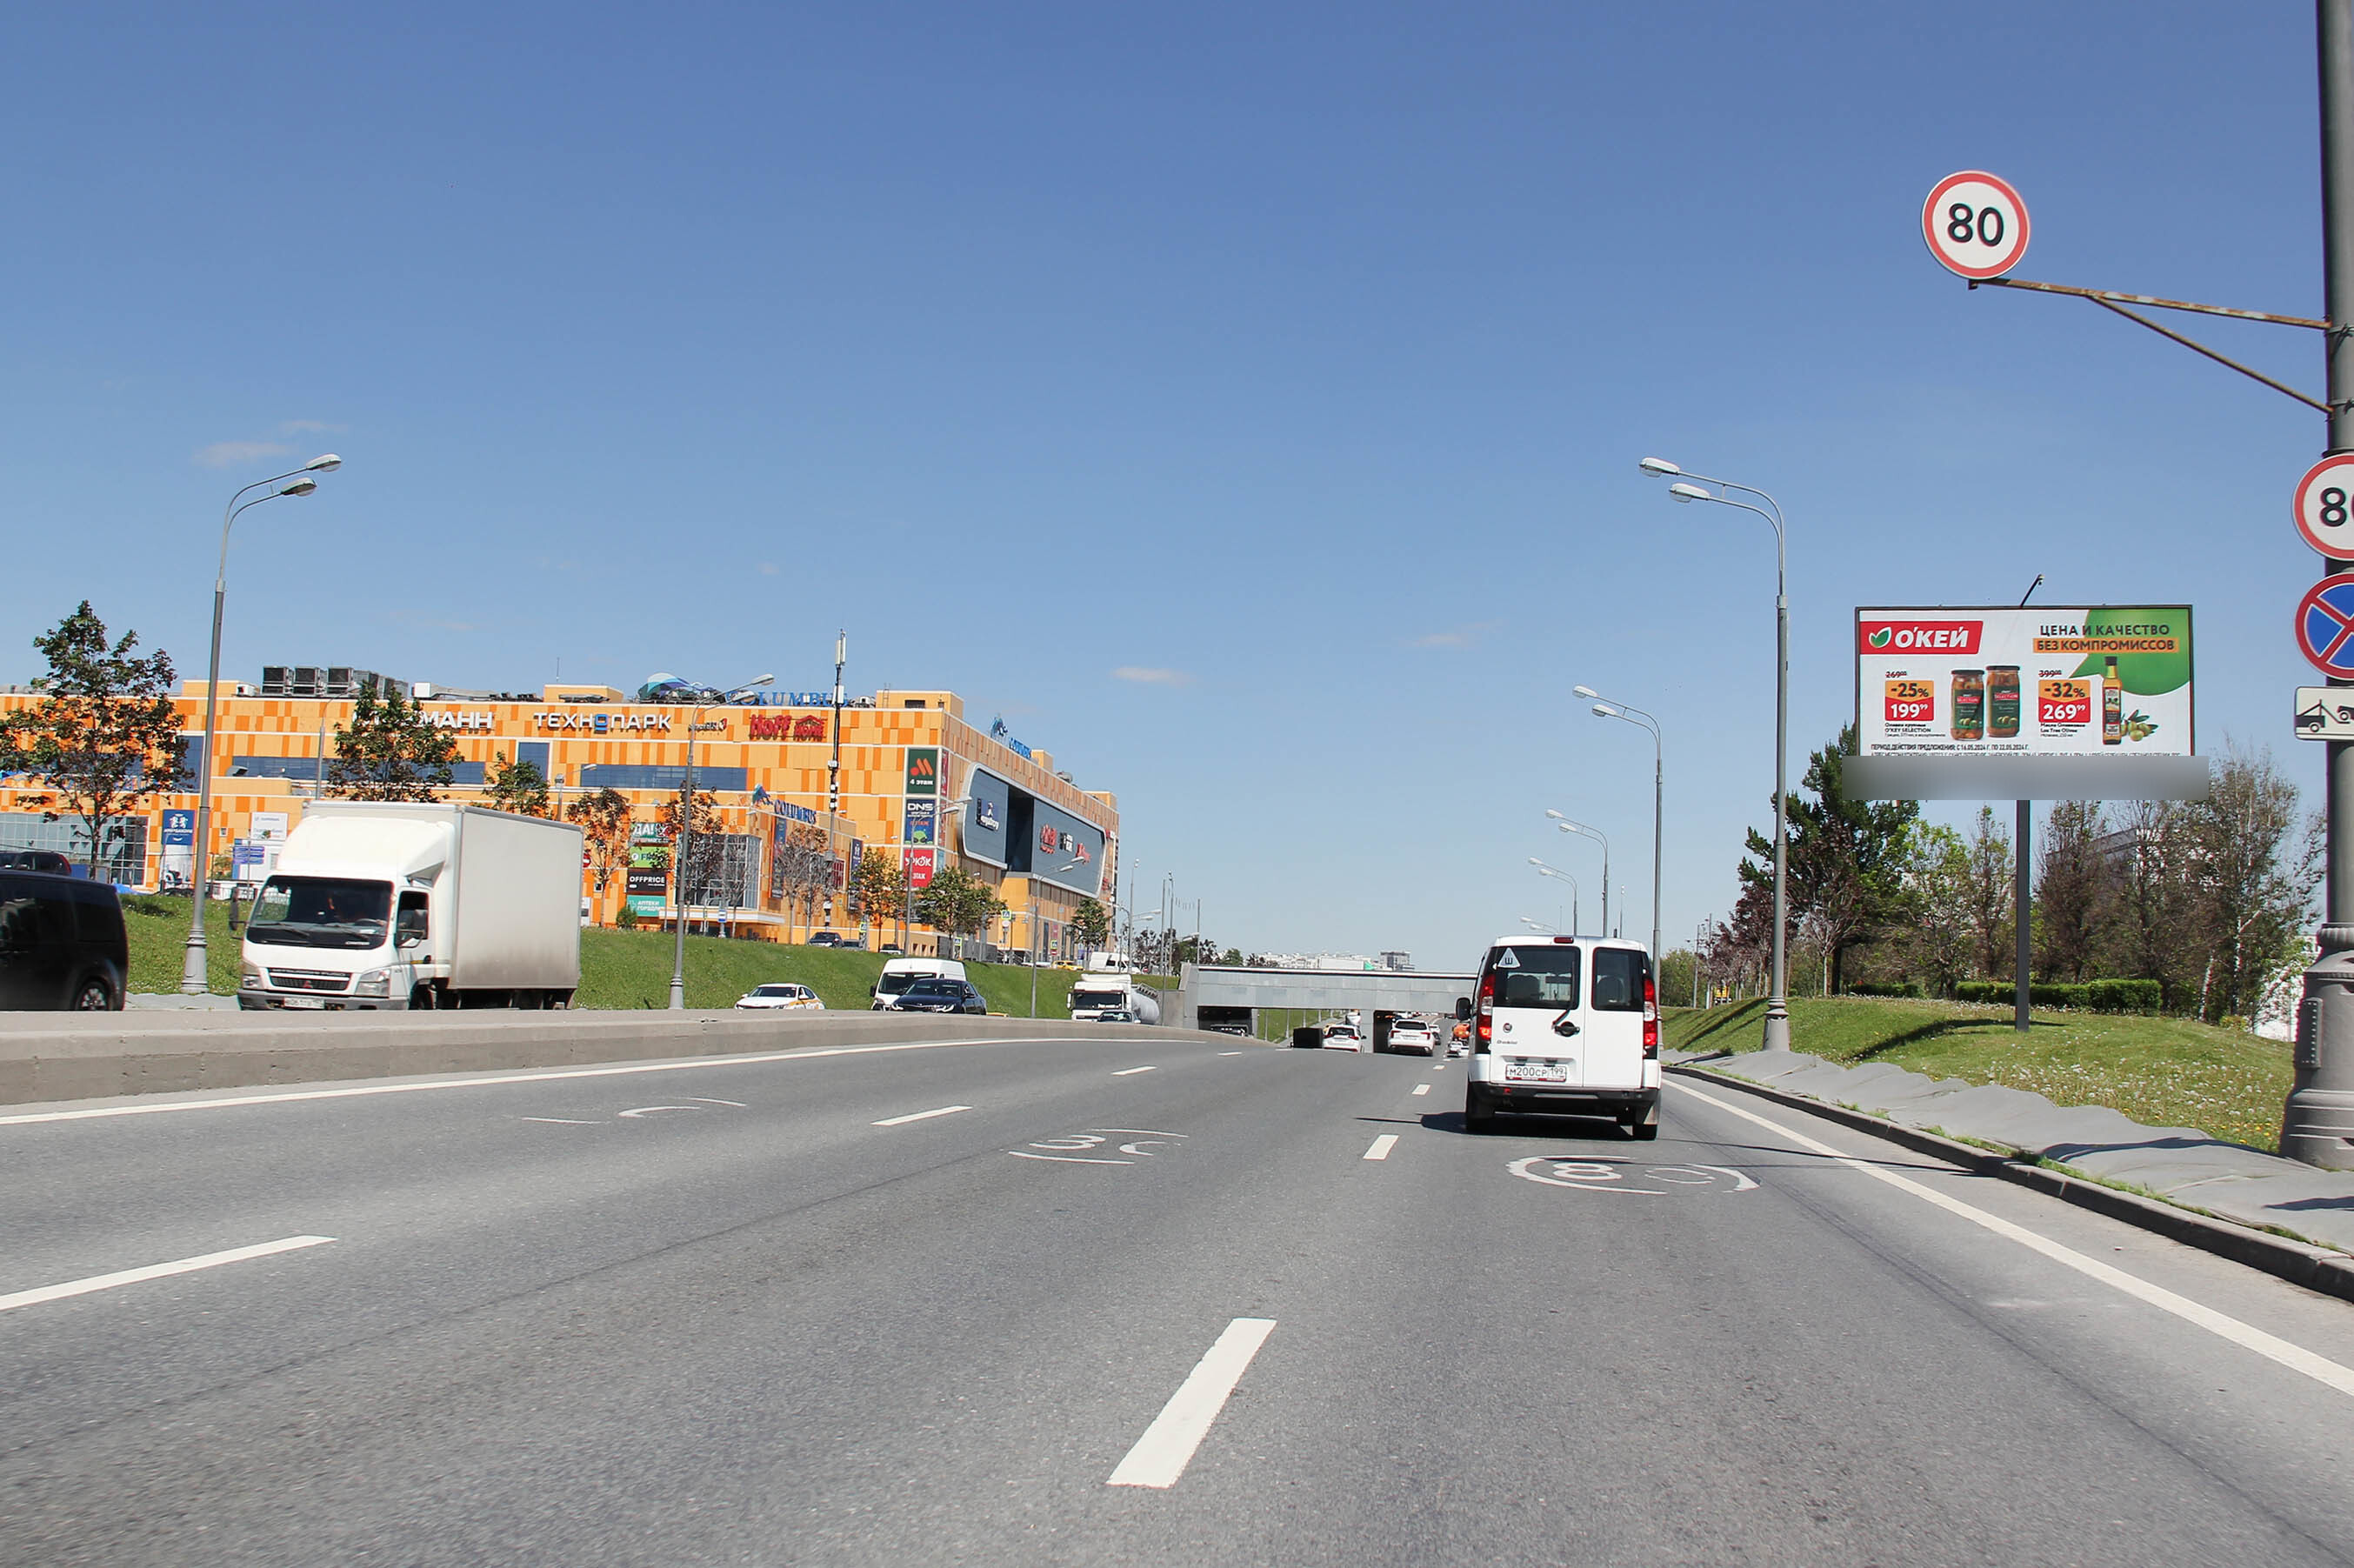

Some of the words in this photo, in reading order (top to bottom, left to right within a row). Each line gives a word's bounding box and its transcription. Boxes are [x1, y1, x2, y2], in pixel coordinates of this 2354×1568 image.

[1948, 204, 2004, 247] 80
[2319, 487, 2354, 528] 8
[2040, 625, 2078, 637] ЦЕНА
[2083, 625, 2091, 636] И
[2096, 624, 2170, 636] КАЧЕСТВО
[2037, 640, 2058, 651] БЕЗ
[2061, 639, 2174, 651] КОМПРОМИССОВ
[1891, 683, 1929, 697] -25%
[2044, 683, 2085, 697] -32%
[534, 712, 671, 731] ТЕХНОПАРК
